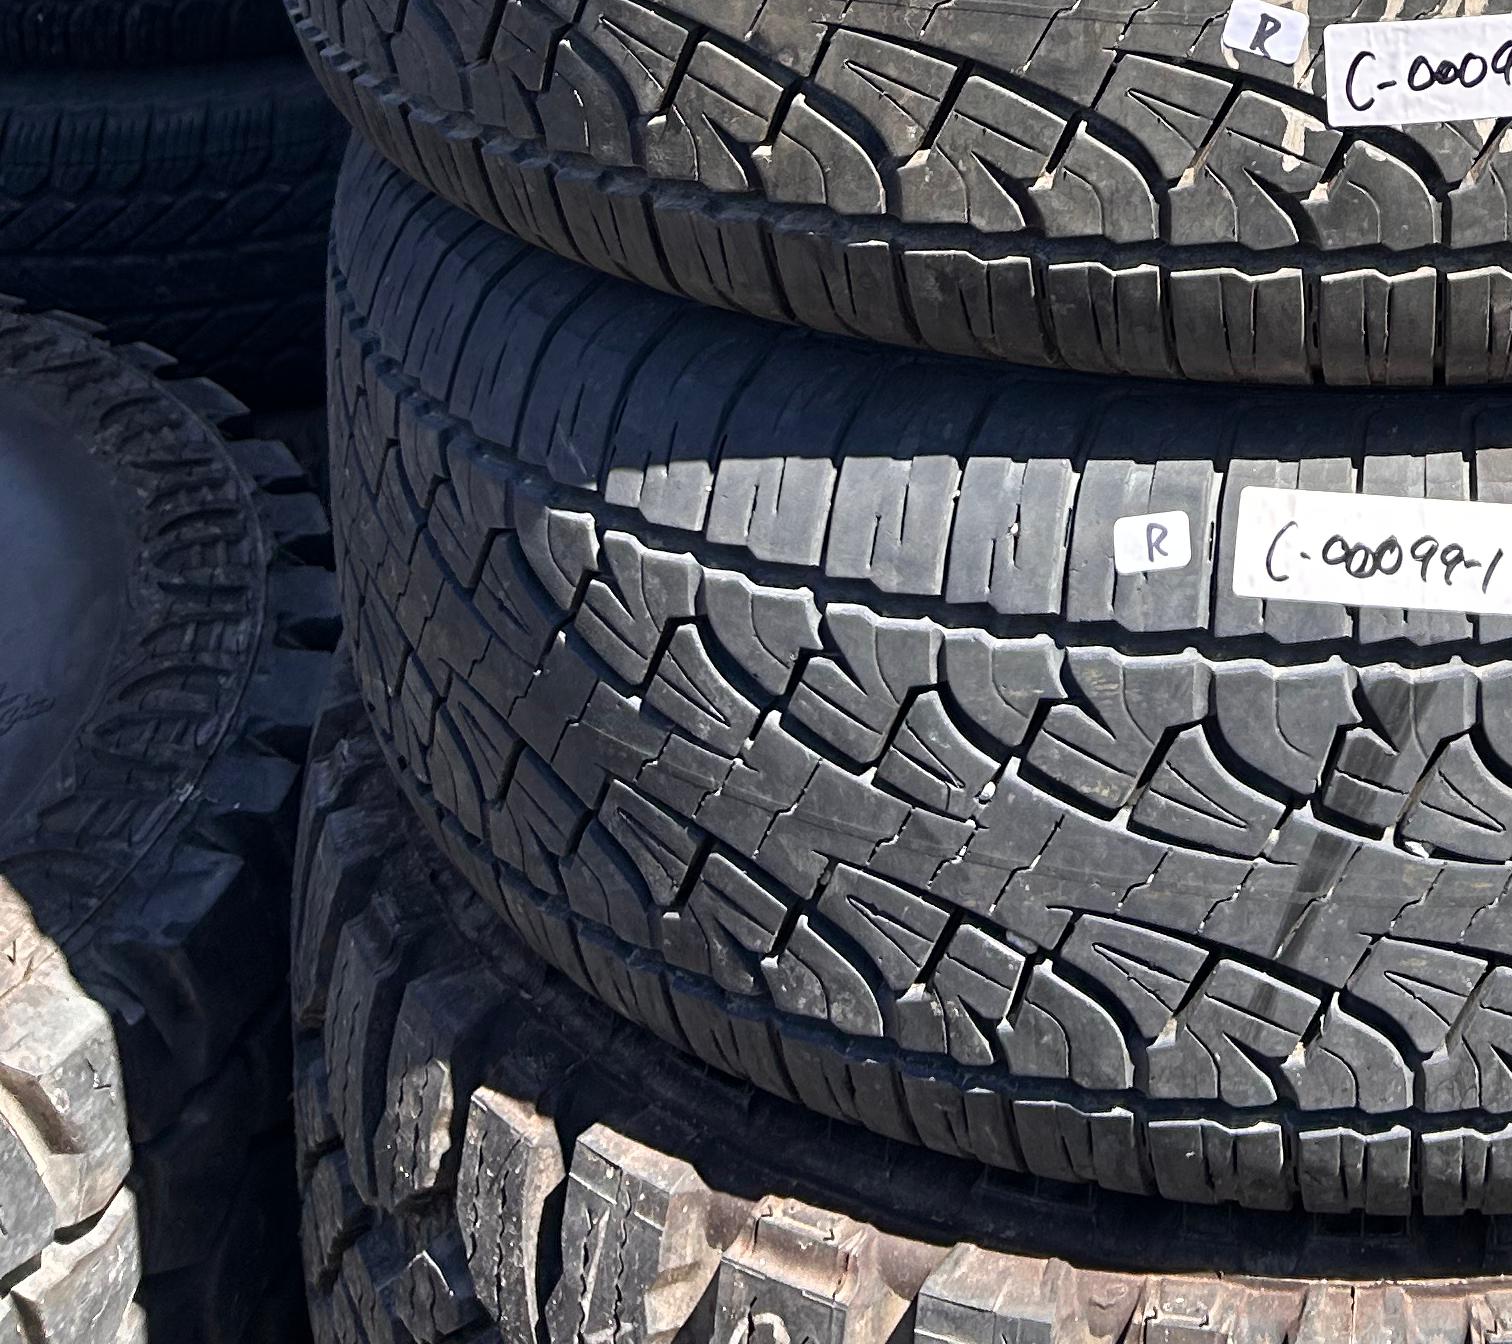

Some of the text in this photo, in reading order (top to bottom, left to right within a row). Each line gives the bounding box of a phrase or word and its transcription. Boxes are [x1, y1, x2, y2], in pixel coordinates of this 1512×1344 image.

[1248, 13, 1282, 58] R
[1145, 522, 1169, 563] R
[1265, 520, 1504, 594] C-00099-1
